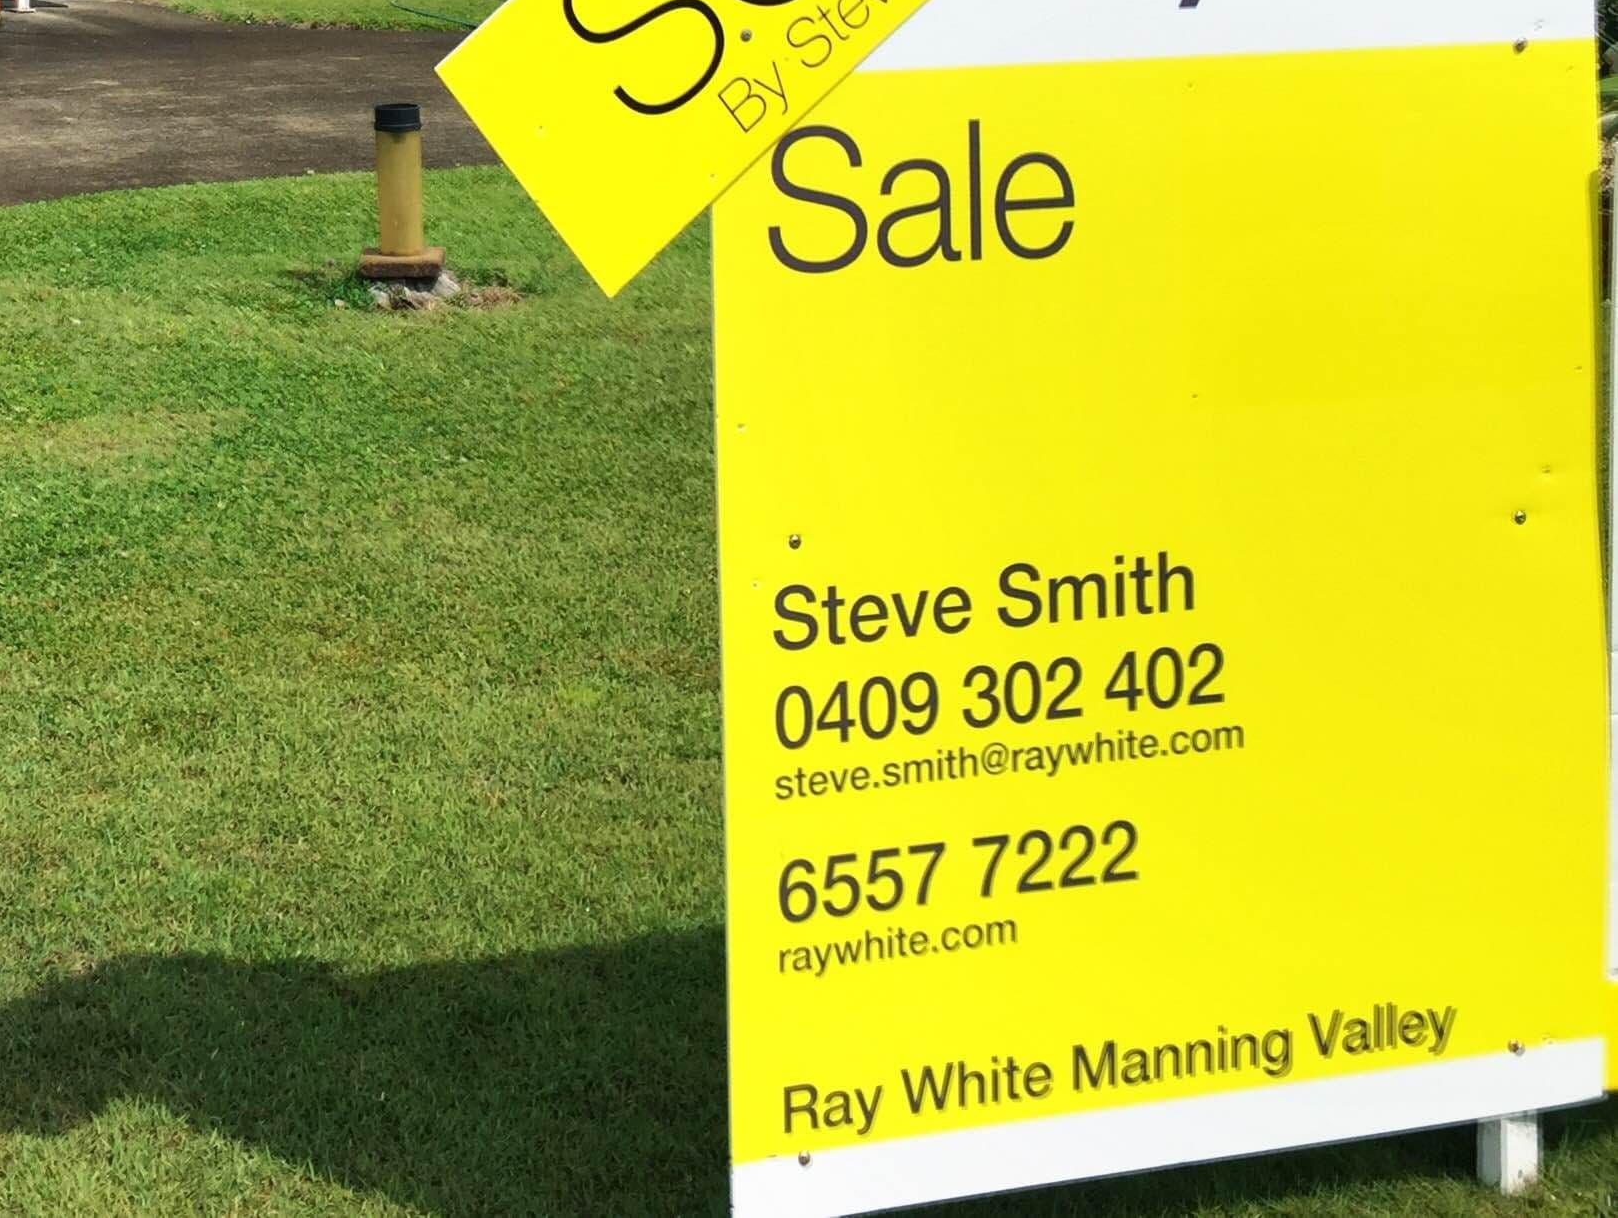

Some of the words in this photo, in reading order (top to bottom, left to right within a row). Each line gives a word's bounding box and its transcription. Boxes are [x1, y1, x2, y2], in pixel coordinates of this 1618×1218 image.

[717, 61, 789, 133] By
[768, 119, 1075, 274] Sale
[773, 583, 972, 651] Steve
[996, 551, 1195, 628] Smith
[774, 670, 939, 750] 0409
[962, 656, 1083, 729] 302
[1103, 642, 1226, 713] 402
[774, 721, 1245, 801] steve.smith@raywhite.com
[778, 842, 946, 924] 6557
[971, 820, 1139, 898] 7222
[779, 919, 1017, 975] raywhite.com
[782, 1083, 883, 1135] Ray
[900, 1055, 1053, 1115] White
[1071, 1024, 1293, 1092] Manning
[1307, 1001, 1457, 1057] Valley
